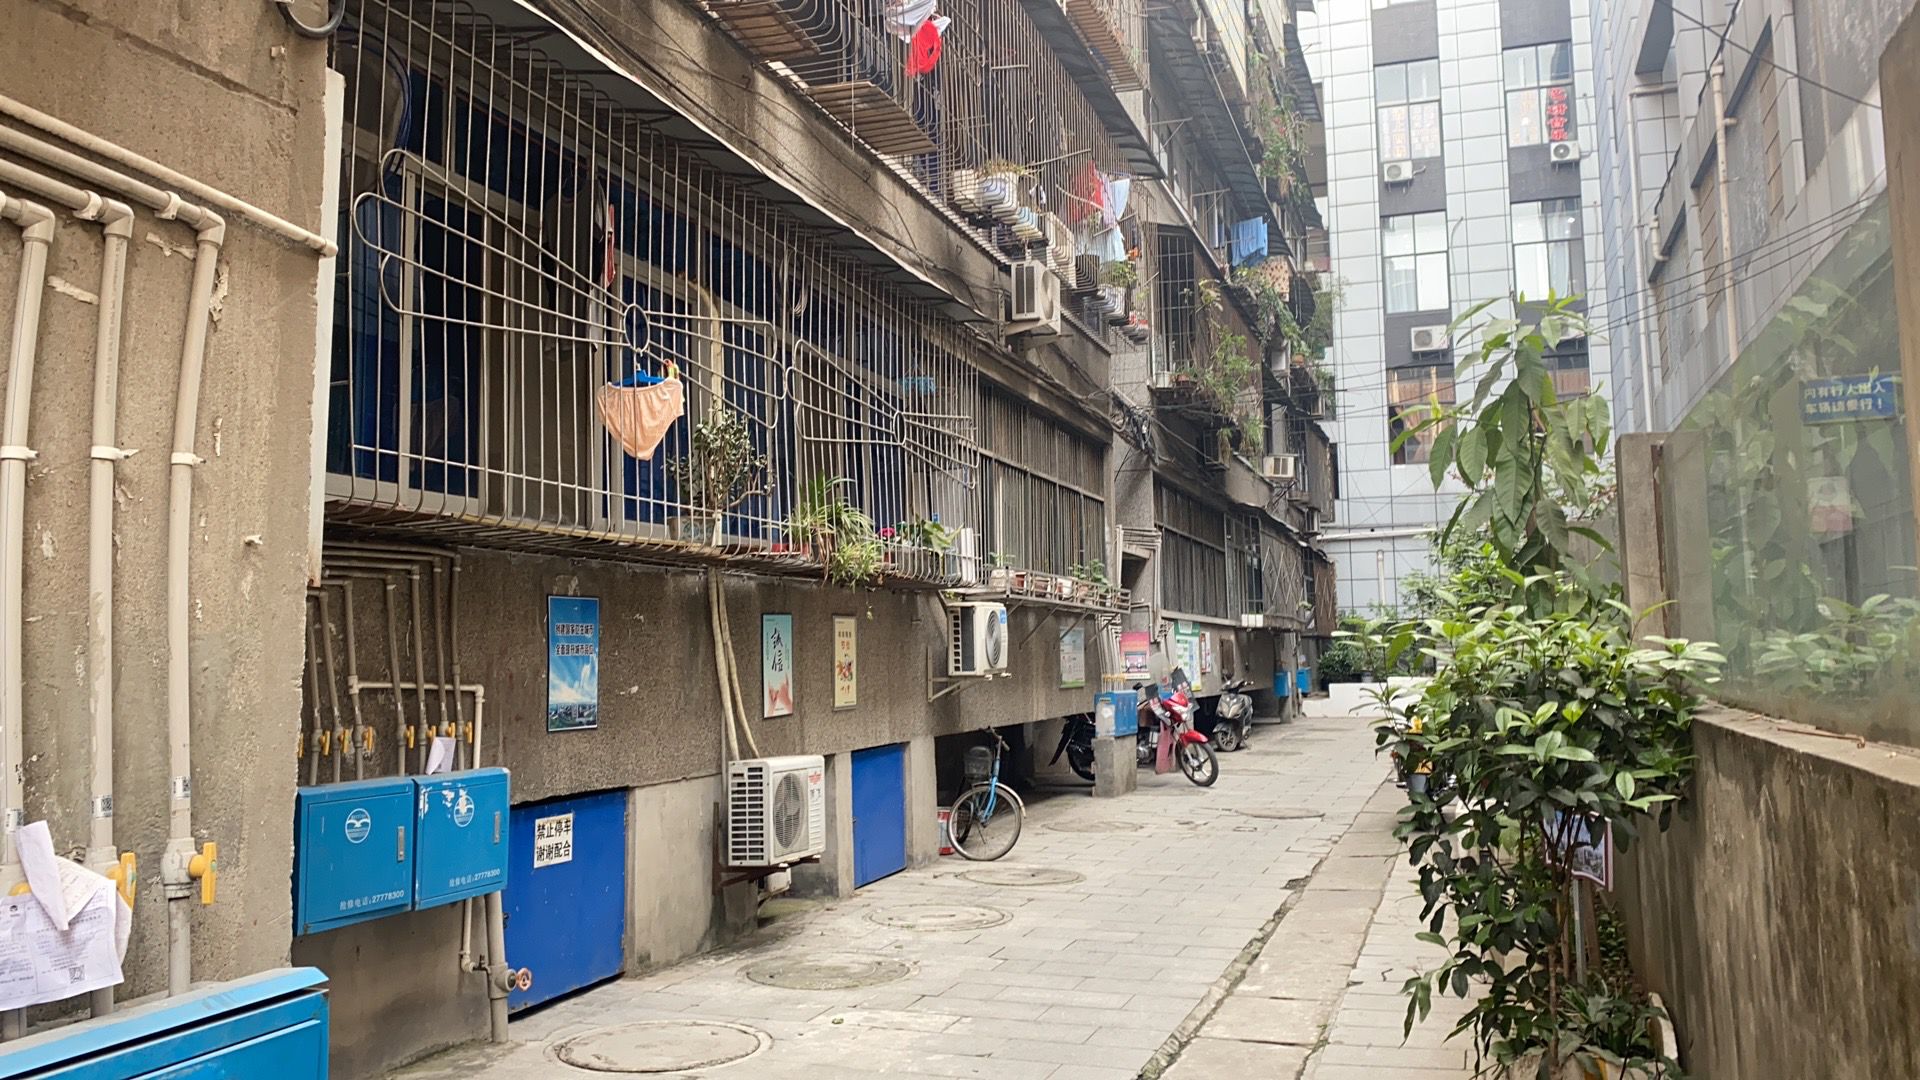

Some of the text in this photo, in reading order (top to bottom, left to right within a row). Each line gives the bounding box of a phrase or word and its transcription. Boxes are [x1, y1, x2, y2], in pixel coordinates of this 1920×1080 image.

[537, 819, 571, 839] 禁止停车
[536, 841, 571, 861] 谢谢配合
